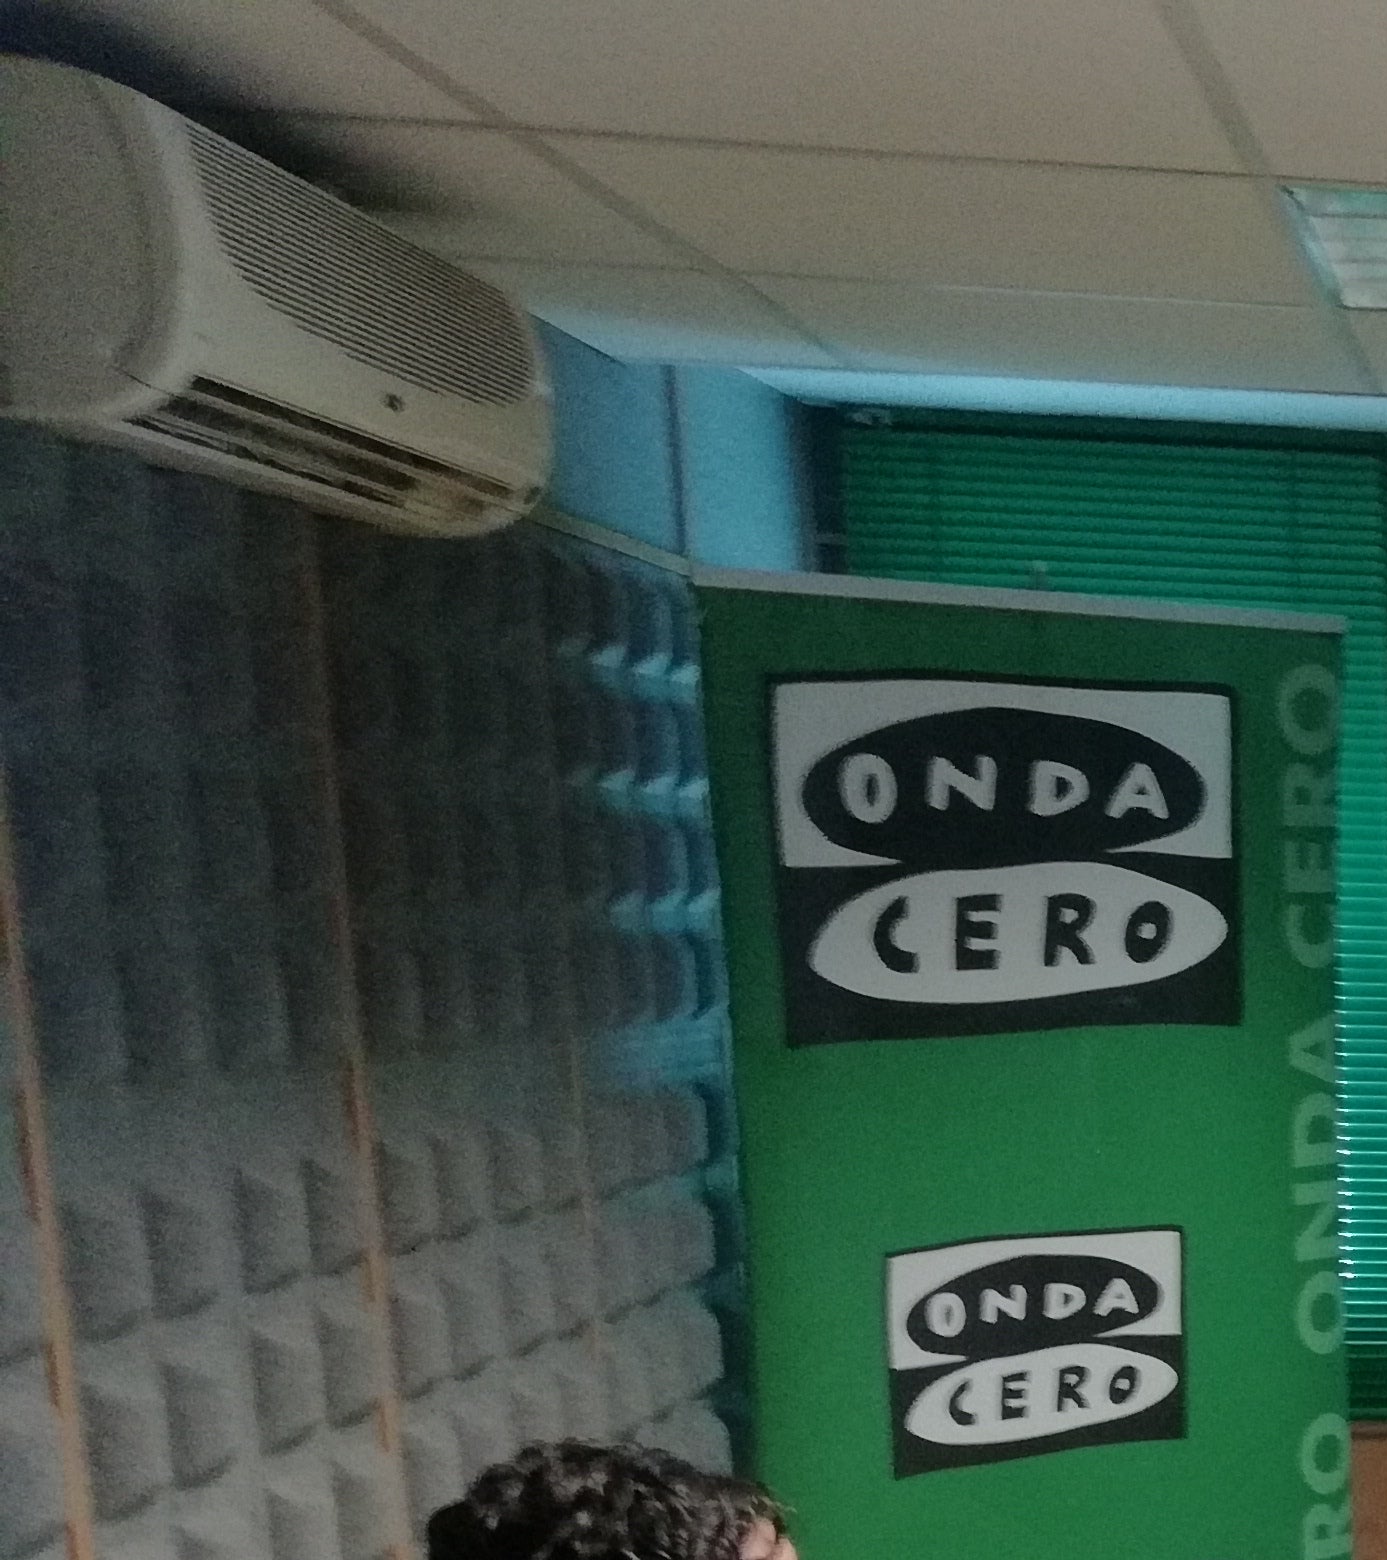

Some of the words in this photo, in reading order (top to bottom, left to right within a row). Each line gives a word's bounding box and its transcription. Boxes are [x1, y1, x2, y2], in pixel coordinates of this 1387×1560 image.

[837, 752, 1170, 824] ONDA
[1278, 663, 1336, 968] CERO
[872, 893, 1173, 974] CERO
[1290, 1012, 1346, 1355] ONDA
[924, 1277, 1140, 1339] ONDA
[947, 1364, 1142, 1427] CERO
